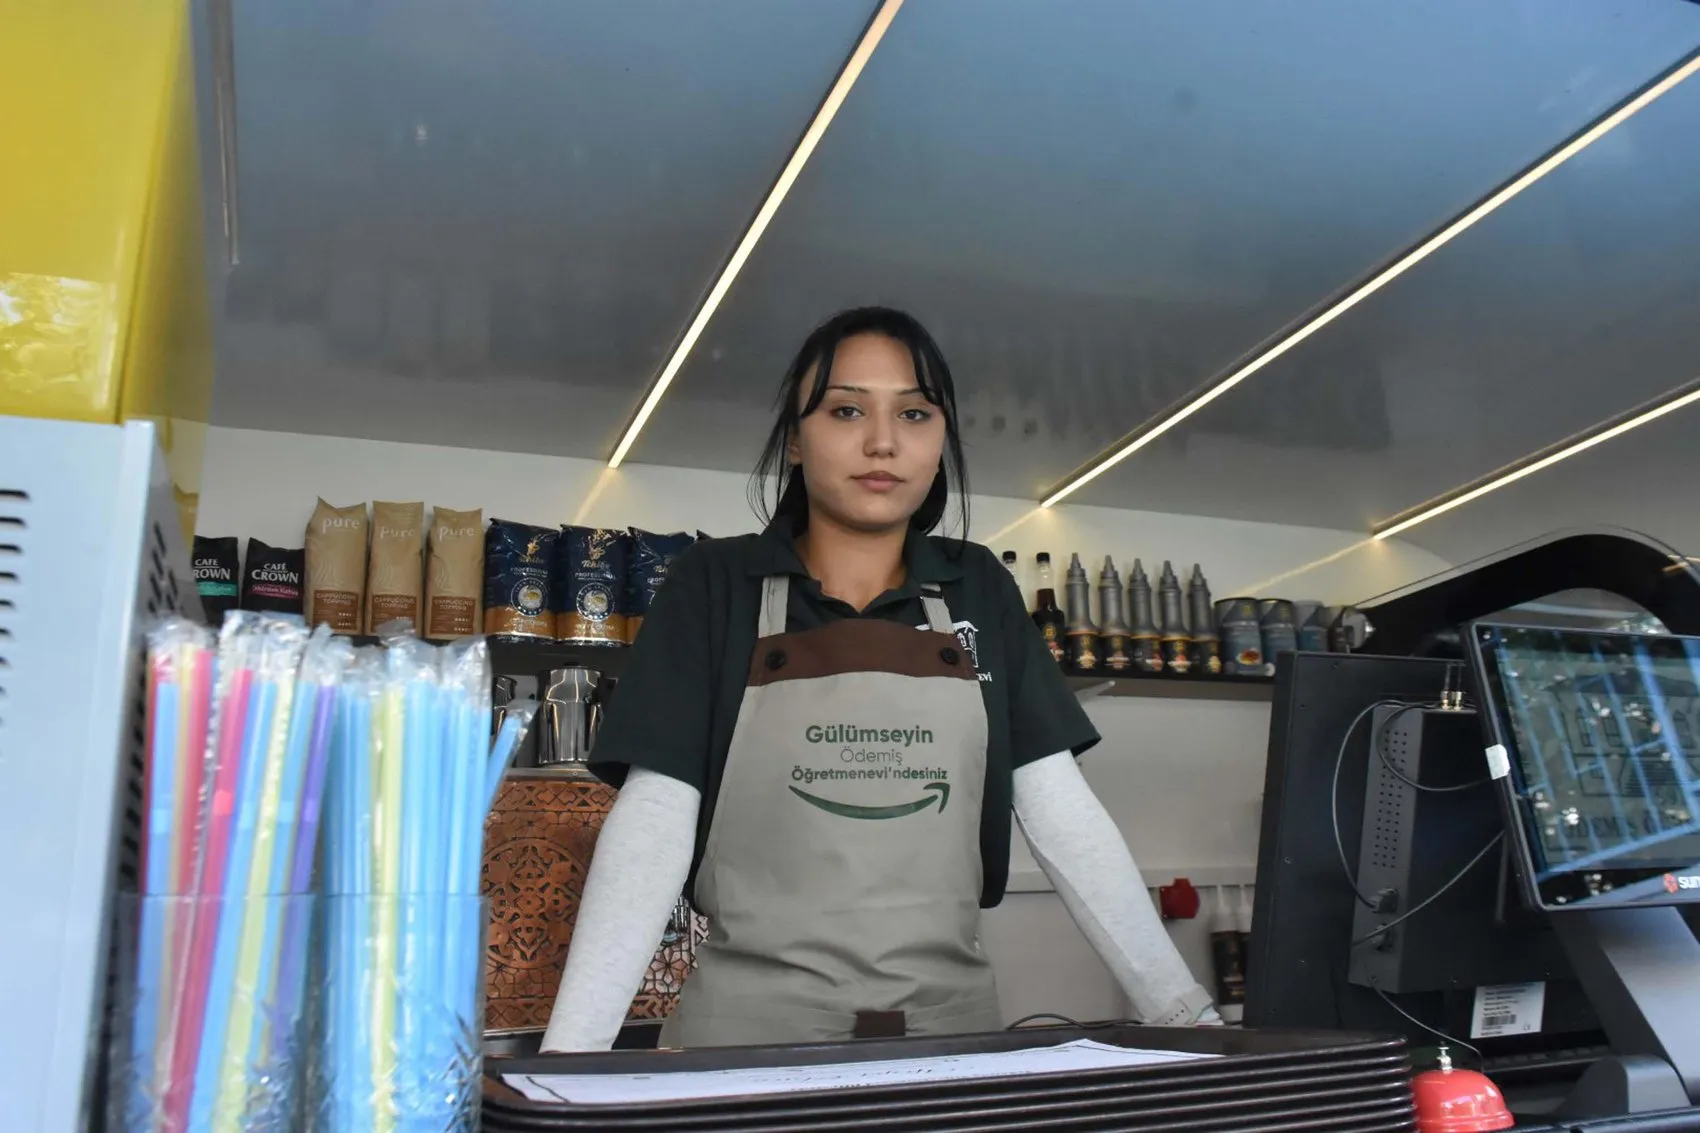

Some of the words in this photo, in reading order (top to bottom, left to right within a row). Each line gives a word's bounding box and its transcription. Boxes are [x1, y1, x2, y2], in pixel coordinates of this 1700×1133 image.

[322, 517, 360, 534] pure
[439, 526, 475, 542] pure
[192, 568, 231, 580] ROWN
[251, 569, 299, 584] CROWN
[805, 724, 933, 747] Gülümseyin
[840, 746, 903, 765] Ödemiş
[791, 766, 948, 784] Öğretmenevi'ndesiniz
